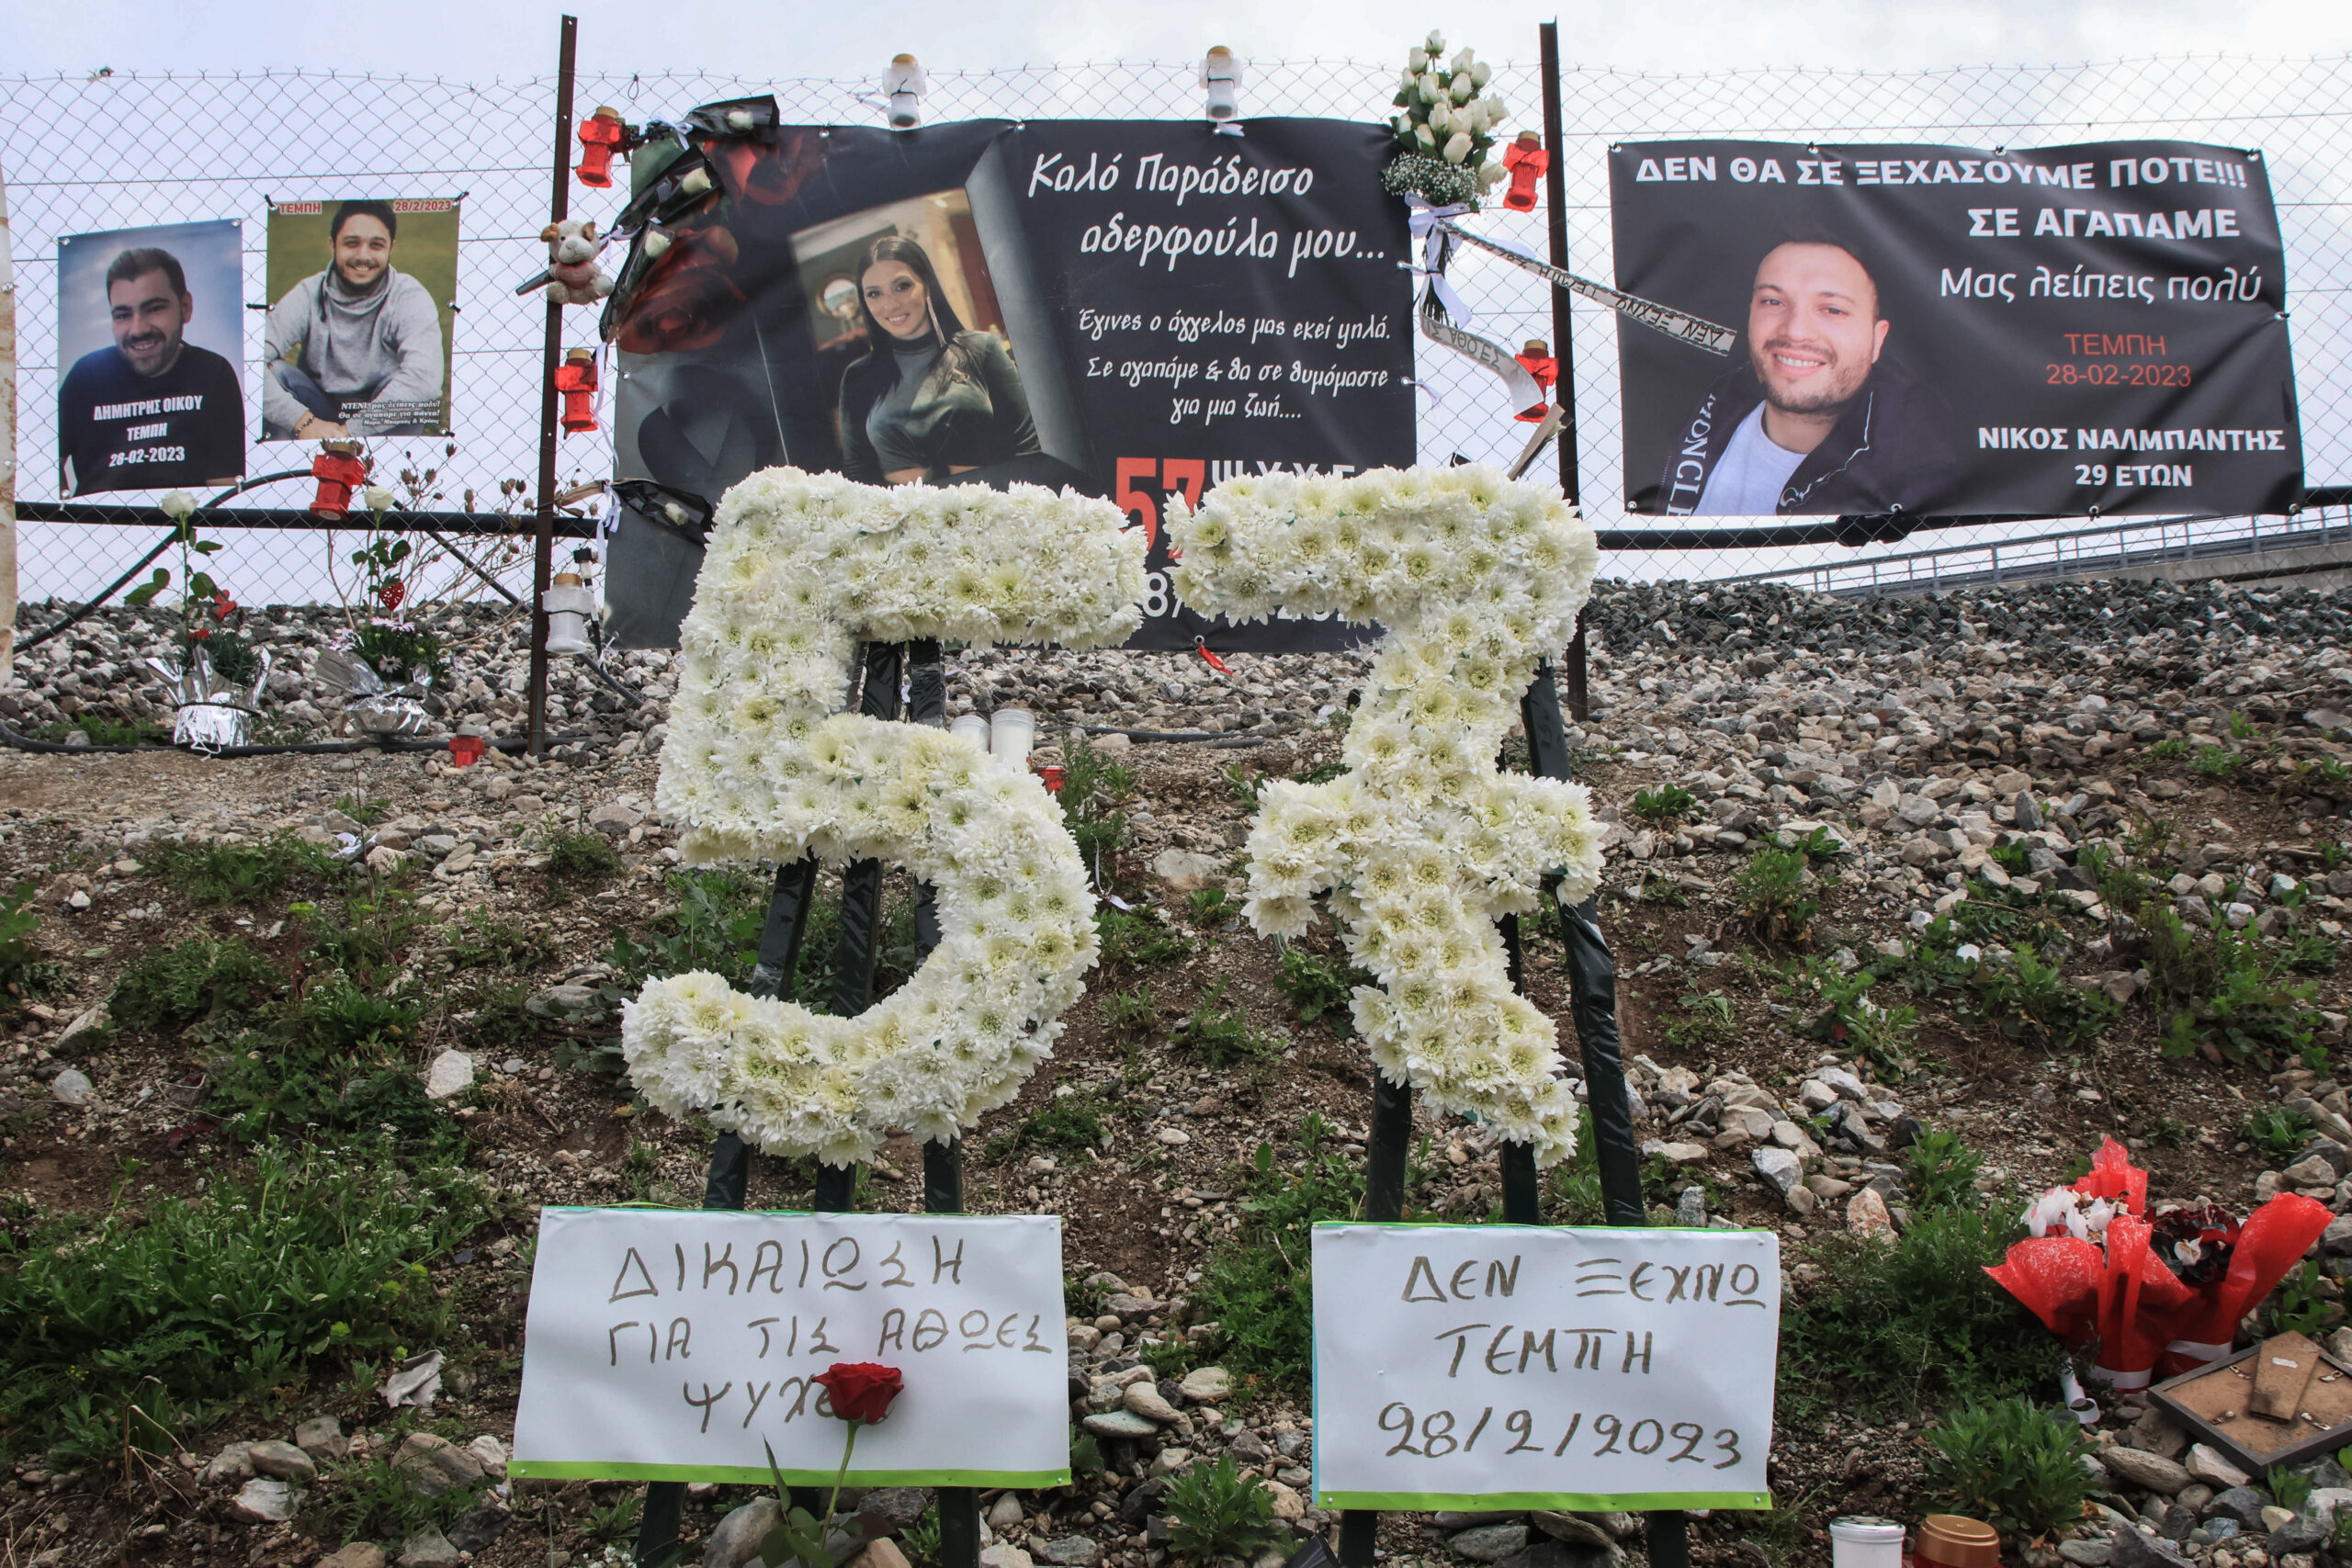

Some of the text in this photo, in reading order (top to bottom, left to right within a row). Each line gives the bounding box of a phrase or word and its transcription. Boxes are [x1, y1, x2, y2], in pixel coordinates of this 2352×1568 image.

[1028, 152, 1314, 206] Καλό Παράδεισο
[1635, 156, 2248, 190] ΔΕΝ ΘΑ ΣΕ ΞΕΧΑΣΟΥΜΕ ΠΟΤΕ!!!
[279, 201, 322, 214] ΤΕΜΠΗ
[393, 200, 452, 212] 28/2/2023
[1968, 209, 2240, 239] ΣΕ ΑΓΑΠΑΜΕ
[1080, 212, 1385, 278] αδερφούλα μου...
[1940, 265, 2262, 304] Μας λείπεις πολύ
[1079, 309, 1142, 341] Έγινες
[1149, 316, 1161, 331] ο
[1168, 310, 1246, 343] άγγελος
[1251, 319, 1285, 344] μας
[1293, 316, 1334, 341] εκεί
[1680, 320, 1724, 347] ΔΕΝ
[2064, 333, 2166, 356] ΤΕΜΠΗ
[1087, 356, 1389, 398] Σε αγαπάμε & θα σε θυμόμαστε
[2046, 364, 2192, 388] 28-02-2023
[93, 395, 203, 421] ΔΗΜΗΤΡΗΣ ΟΙΚΟΥ
[1170, 396, 1201, 425] για
[1205, 398, 1236, 426] μια
[127, 423, 167, 442] ΤΕΜΠΗ
[1978, 427, 2286, 452] ΝΙΚΟΣ ΝΑΛΜΠΑΝΤΗΣ
[109, 446, 185, 468] 28-02-2023
[2075, 464, 2193, 488] 29 ΕΤΩΝ
[1116, 457, 1205, 558] 57
[608, 1235, 964, 1303] ΔΙΚΑΙΩΣΗ
[1401, 1255, 1767, 1309] ΔΕΝ ΞΕΧΝΩ
[609, 1307, 1054, 1366] ΓΙΑ ΤΙΣ ΑΘΩΕΣ
[1434, 1323, 1653, 1378] ΤΕΜΠΗ
[683, 1374, 834, 1434] ΨΥΧΕ
[1377, 1402, 1742, 1470] 28/2/2023
